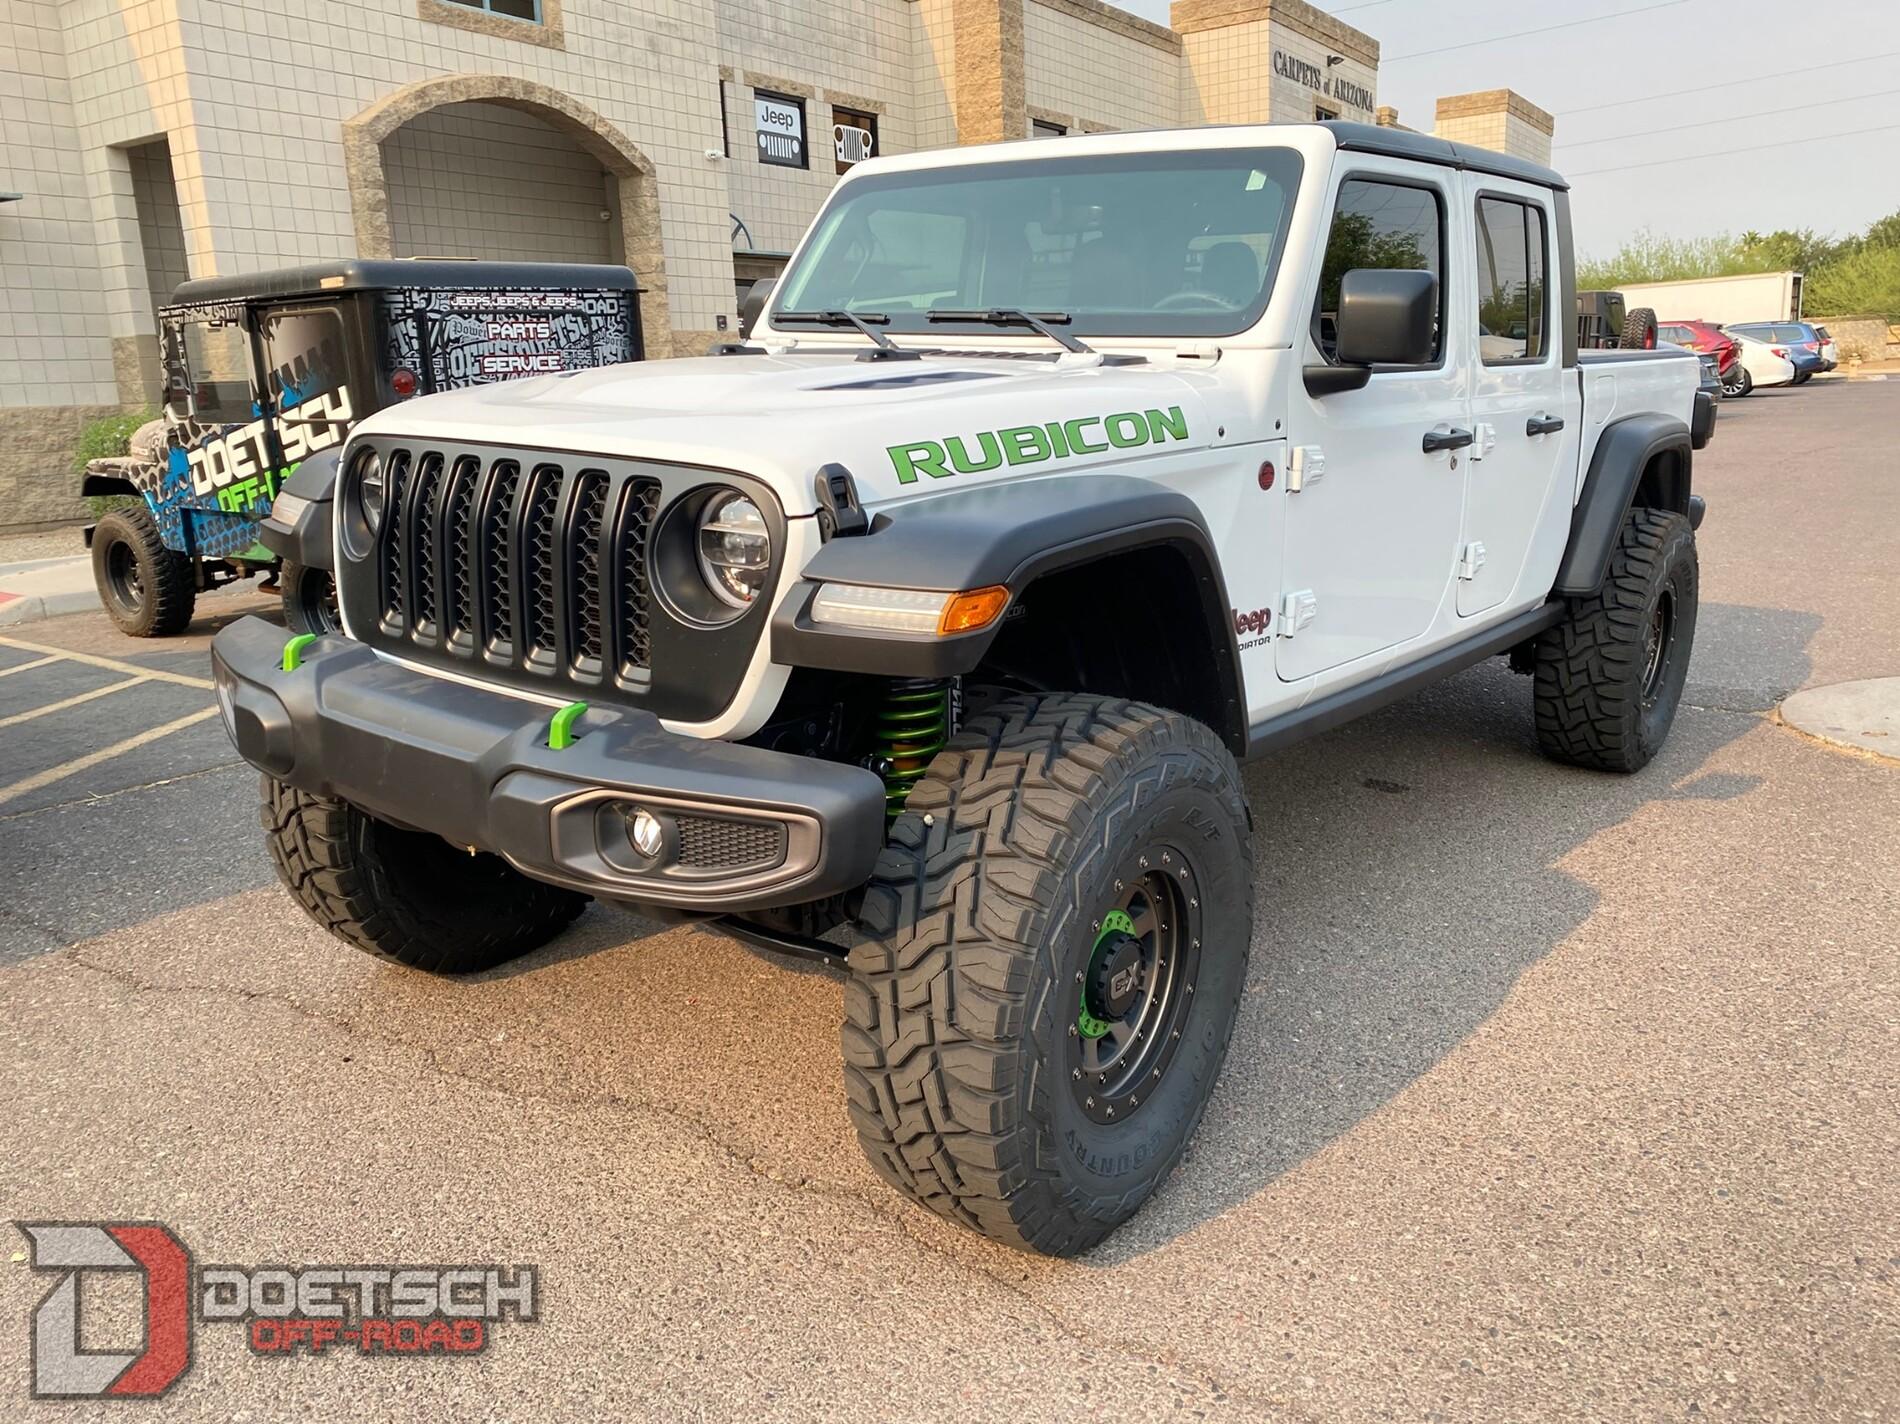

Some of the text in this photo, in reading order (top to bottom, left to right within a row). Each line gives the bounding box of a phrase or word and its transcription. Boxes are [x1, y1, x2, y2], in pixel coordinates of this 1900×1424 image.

[1273, 50, 1374, 113] CARPETS of ARIZONA
[762, 105, 794, 131] Jeep
[541, 296, 577, 307] JEEPS
[488, 322, 550, 340] PARTS
[483, 356, 562, 373] SERVICE
[886, 406, 1189, 485] RUBICON
